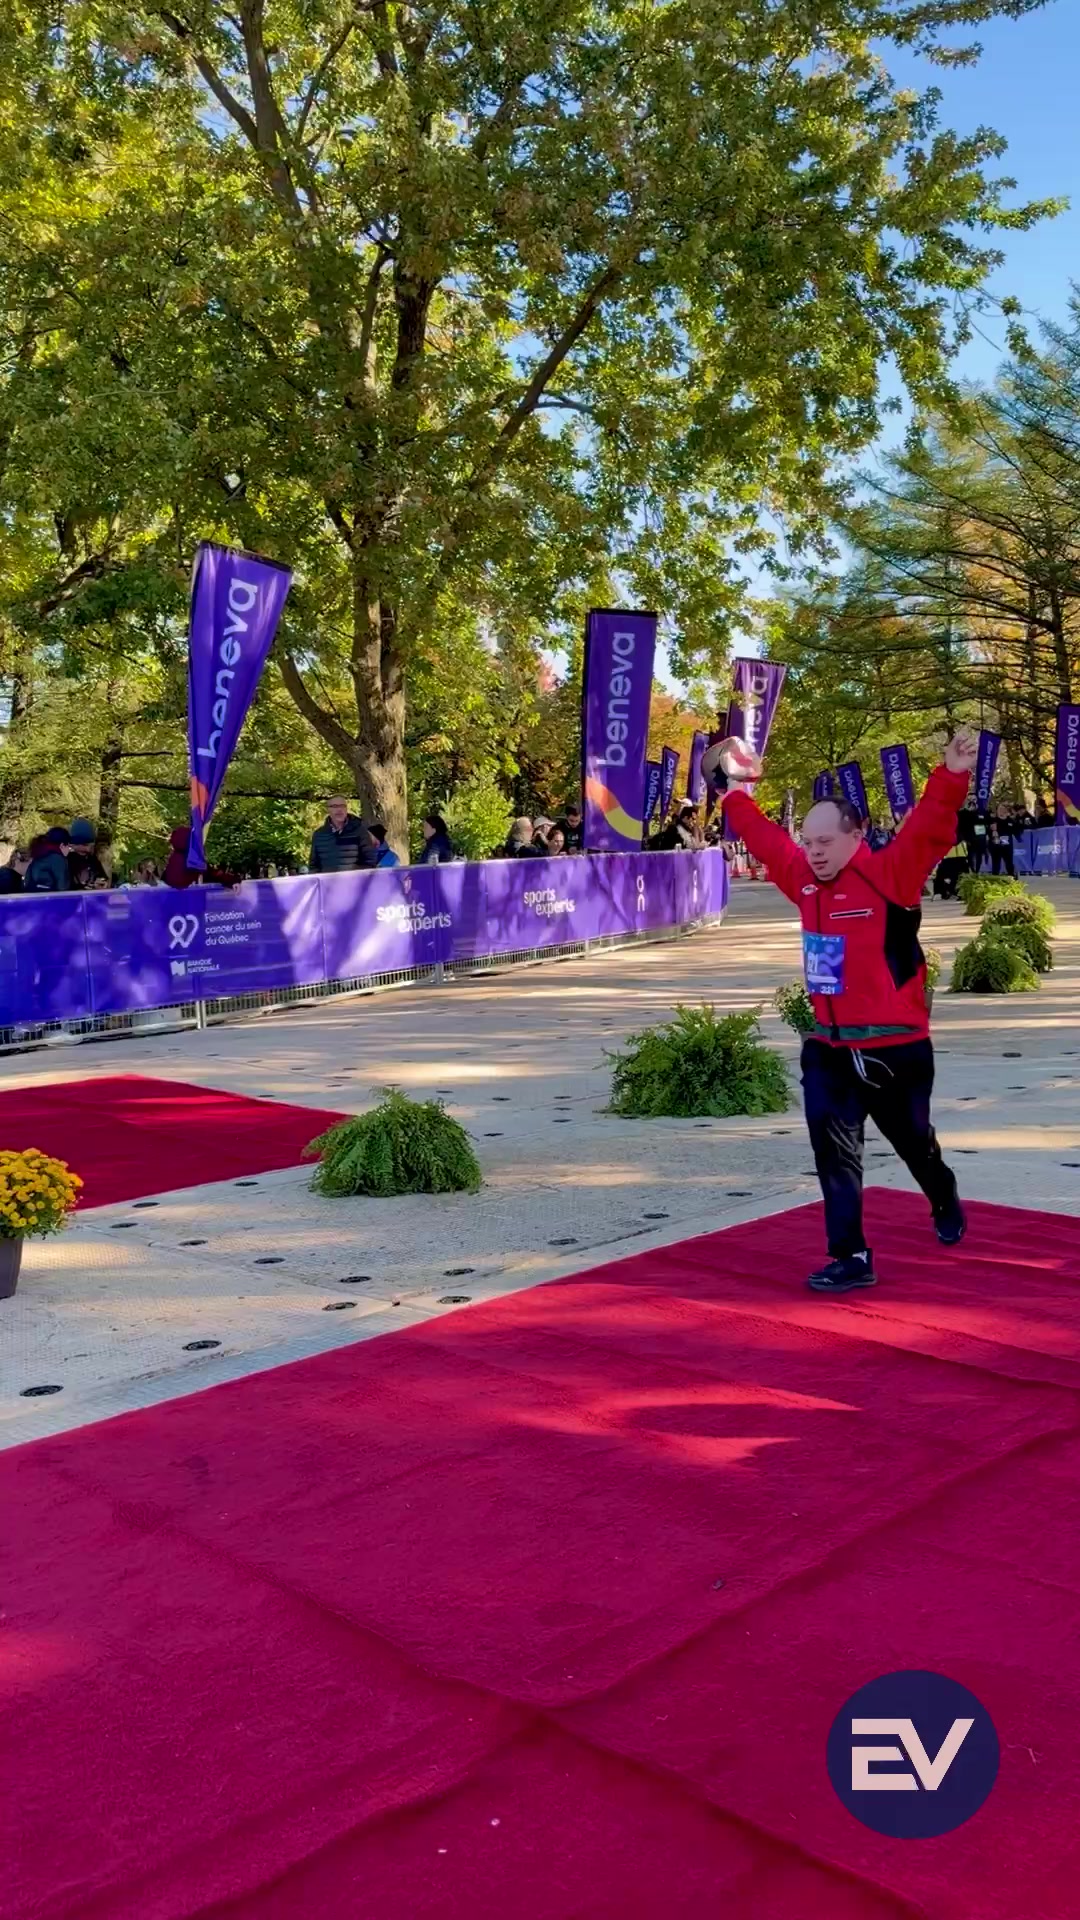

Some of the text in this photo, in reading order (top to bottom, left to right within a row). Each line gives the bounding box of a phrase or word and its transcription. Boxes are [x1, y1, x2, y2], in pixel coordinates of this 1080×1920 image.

[596, 631, 636, 767] beneva
[1060, 714, 1080, 785] beneva
[889, 752, 907, 807] beneva
[523, 887, 556, 907] sports
[204, 910, 245, 923] Fondation
[376, 900, 425, 923] sports
[535, 898, 576, 918] experts
[204, 919, 262, 935] cancer du sein
[398, 911, 453, 935] experts
[204, 936, 217, 947] du
